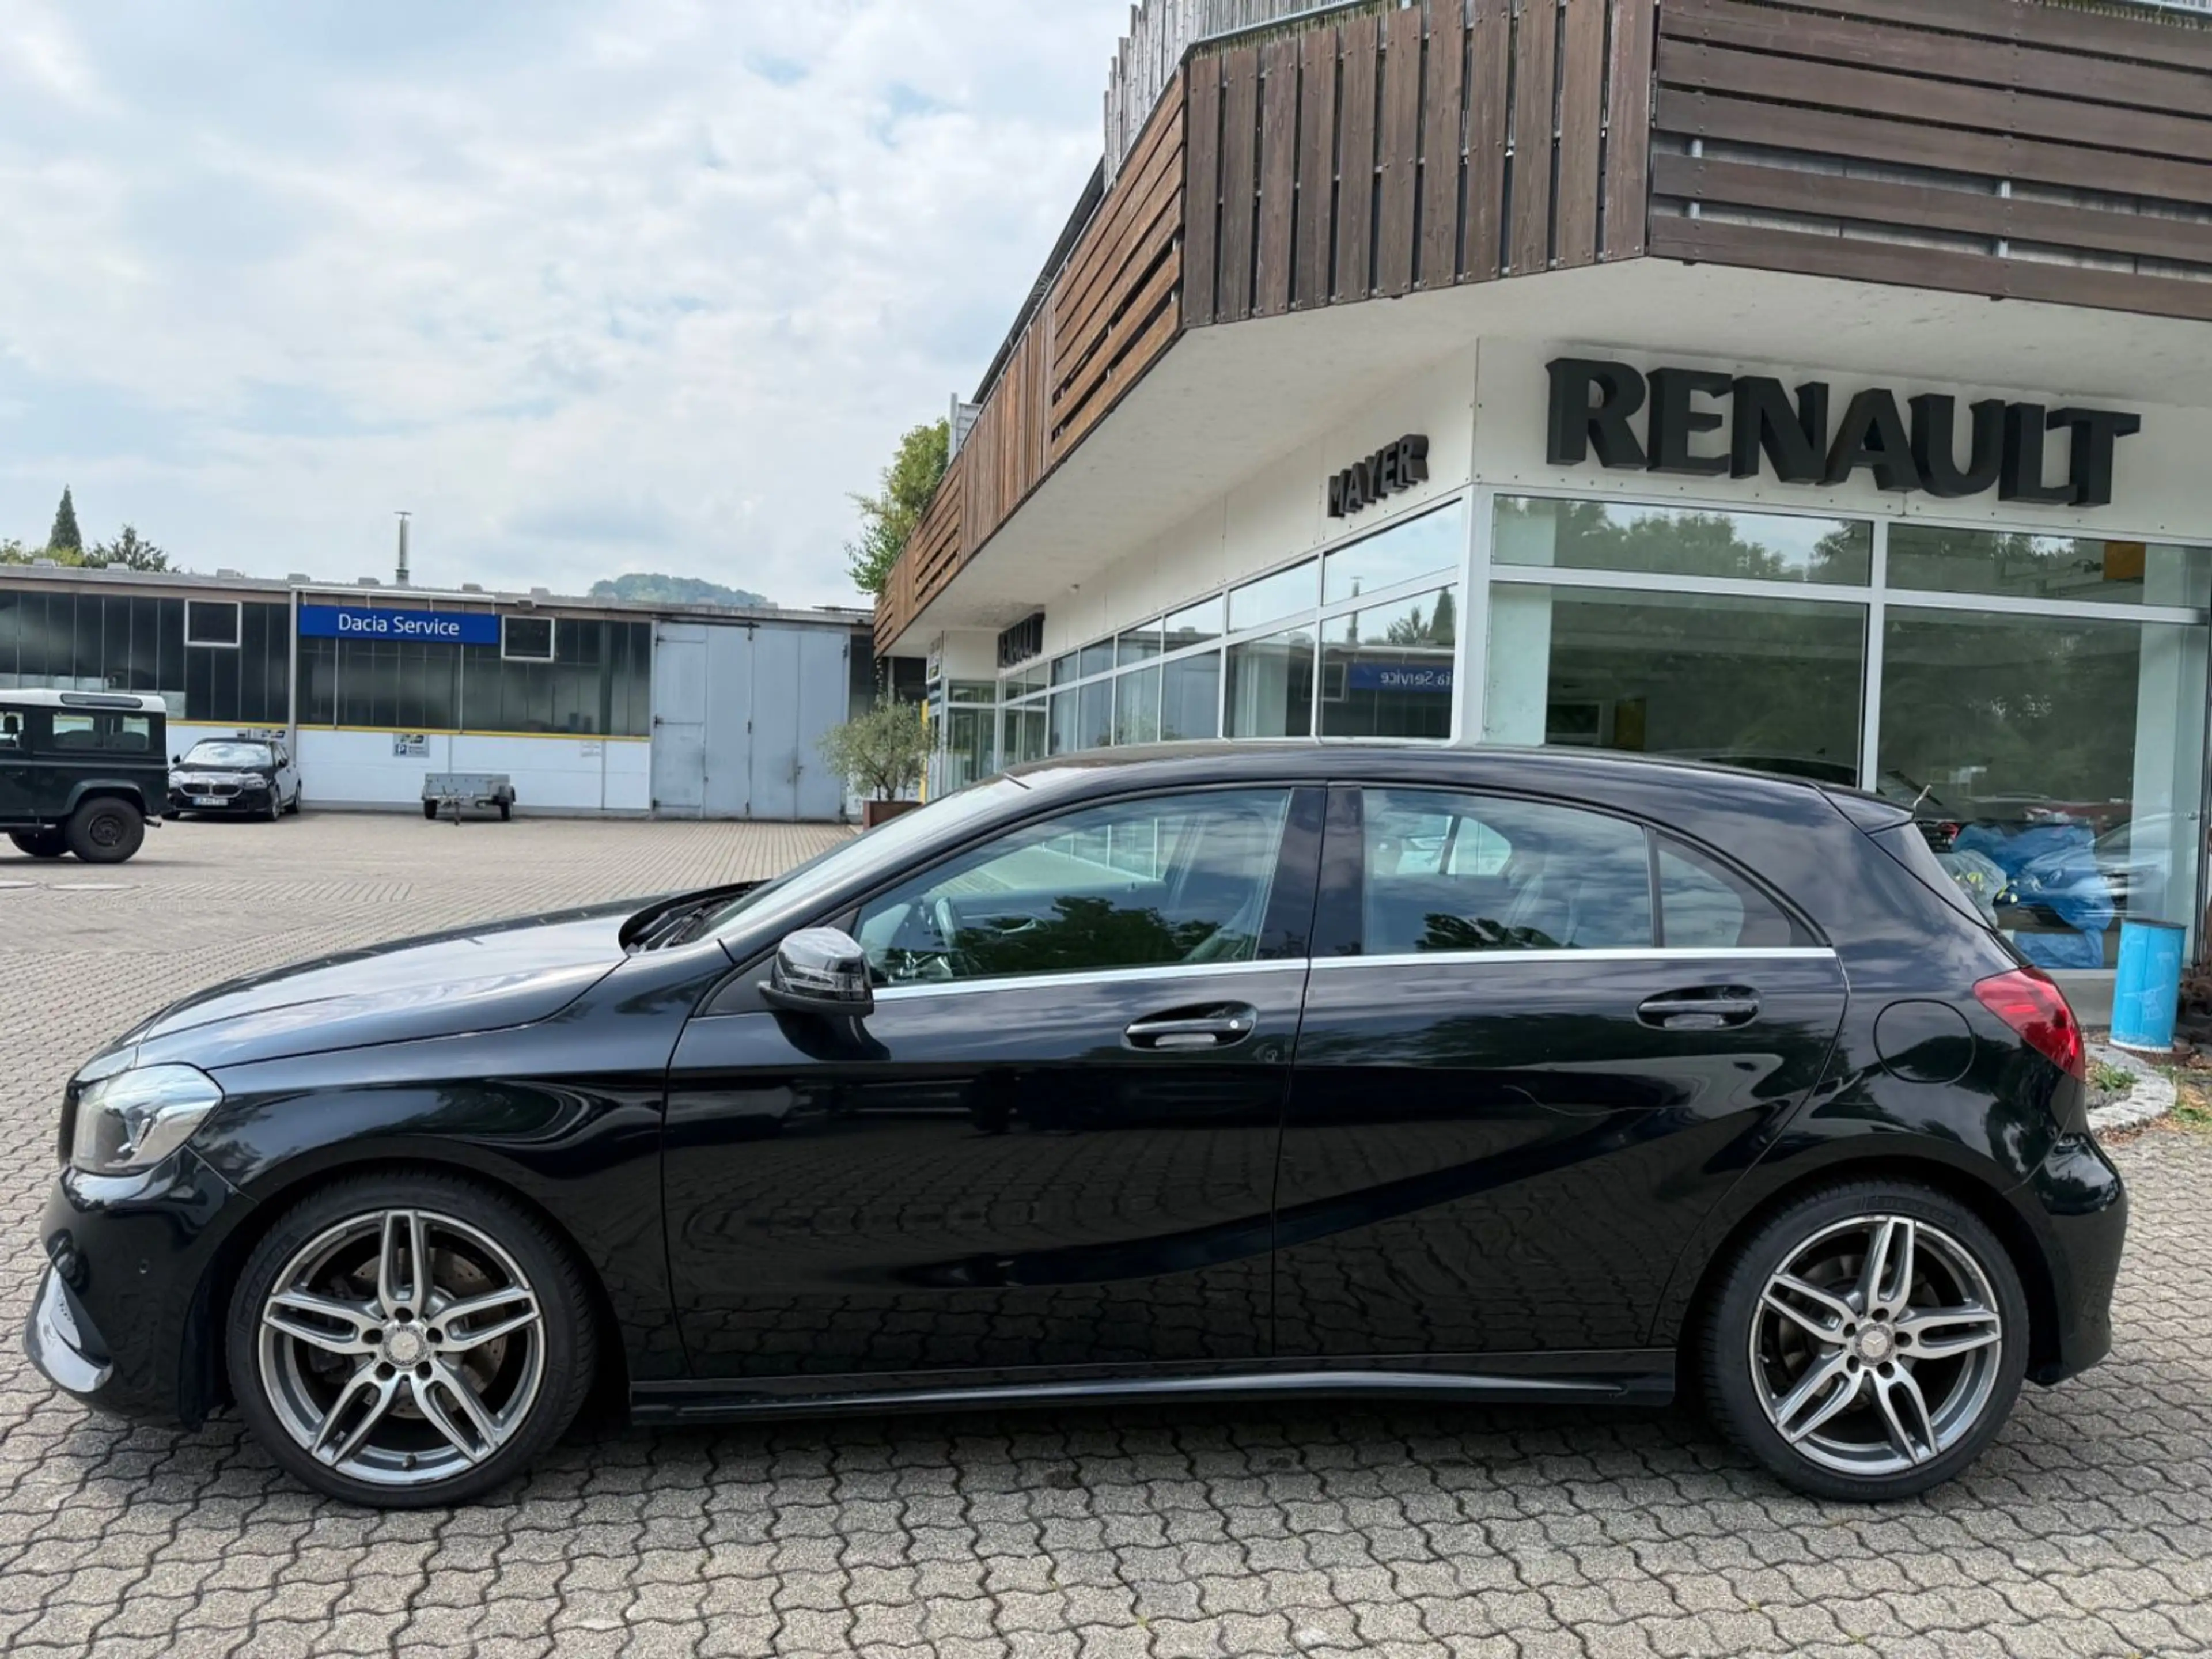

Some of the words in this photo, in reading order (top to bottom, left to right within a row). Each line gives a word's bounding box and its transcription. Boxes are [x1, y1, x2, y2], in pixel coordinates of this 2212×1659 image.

[1545, 357, 2142, 507] RENAULT
[1327, 434, 1429, 518] MAYER
[338, 613, 387, 632] Dacia
[393, 616, 460, 636] Service
